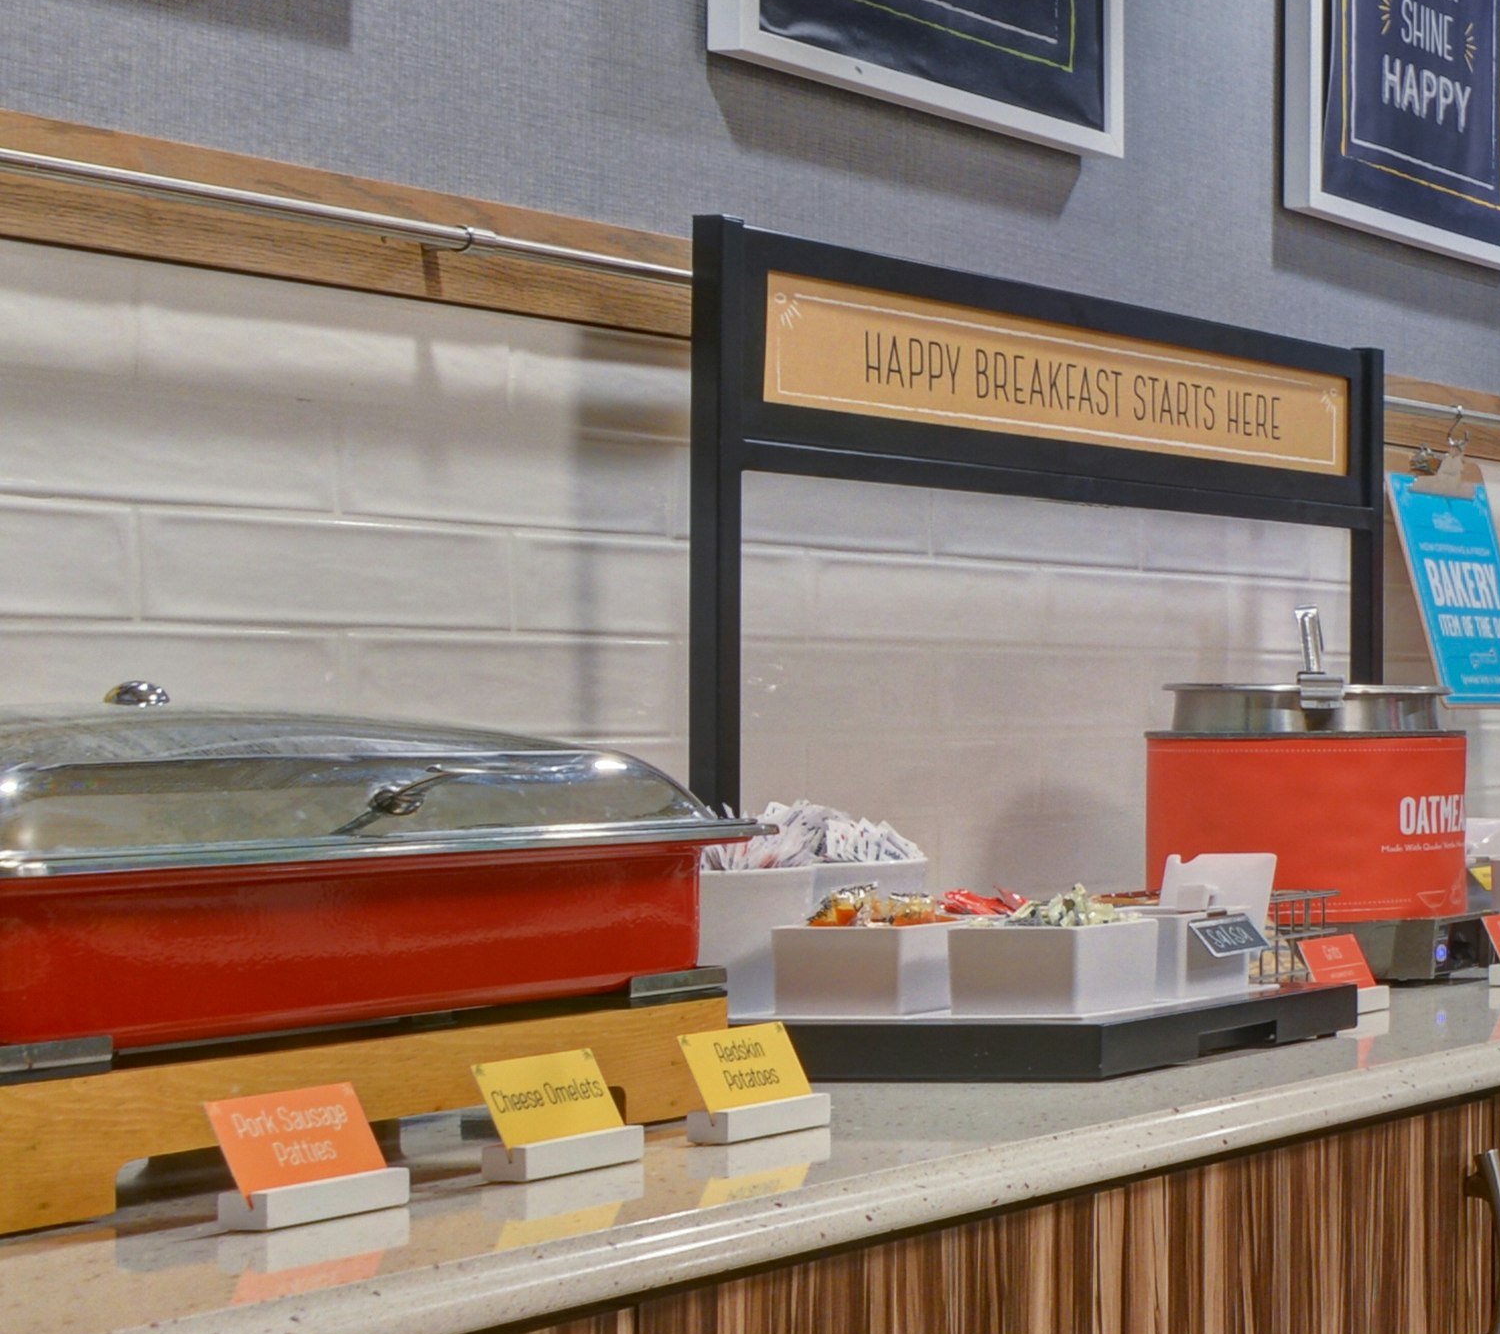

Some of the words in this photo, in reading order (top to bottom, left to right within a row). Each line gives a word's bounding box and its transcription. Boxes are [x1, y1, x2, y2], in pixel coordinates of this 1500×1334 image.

[1382, 54, 1472, 134] HAPPY
[863, 330, 960, 395] HAPPY
[975, 348, 1122, 417] BREAKFAST
[1133, 374, 1216, 431] STARTS
[1227, 389, 1281, 441] HERE
[1438, 614, 1463, 637] ITEM
[1461, 616, 1475, 638] OF
[1474, 616, 1494, 638] THE
[713, 1037, 766, 1063] Redskin
[723, 1068, 781, 1091] Potatoes
[490, 1090, 545, 1114] Cheese
[542, 1077, 604, 1106] Omelets
[231, 1110, 279, 1139] Pork
[276, 1103, 349, 1131] Sausage
[271, 1140, 338, 1167] Patties
